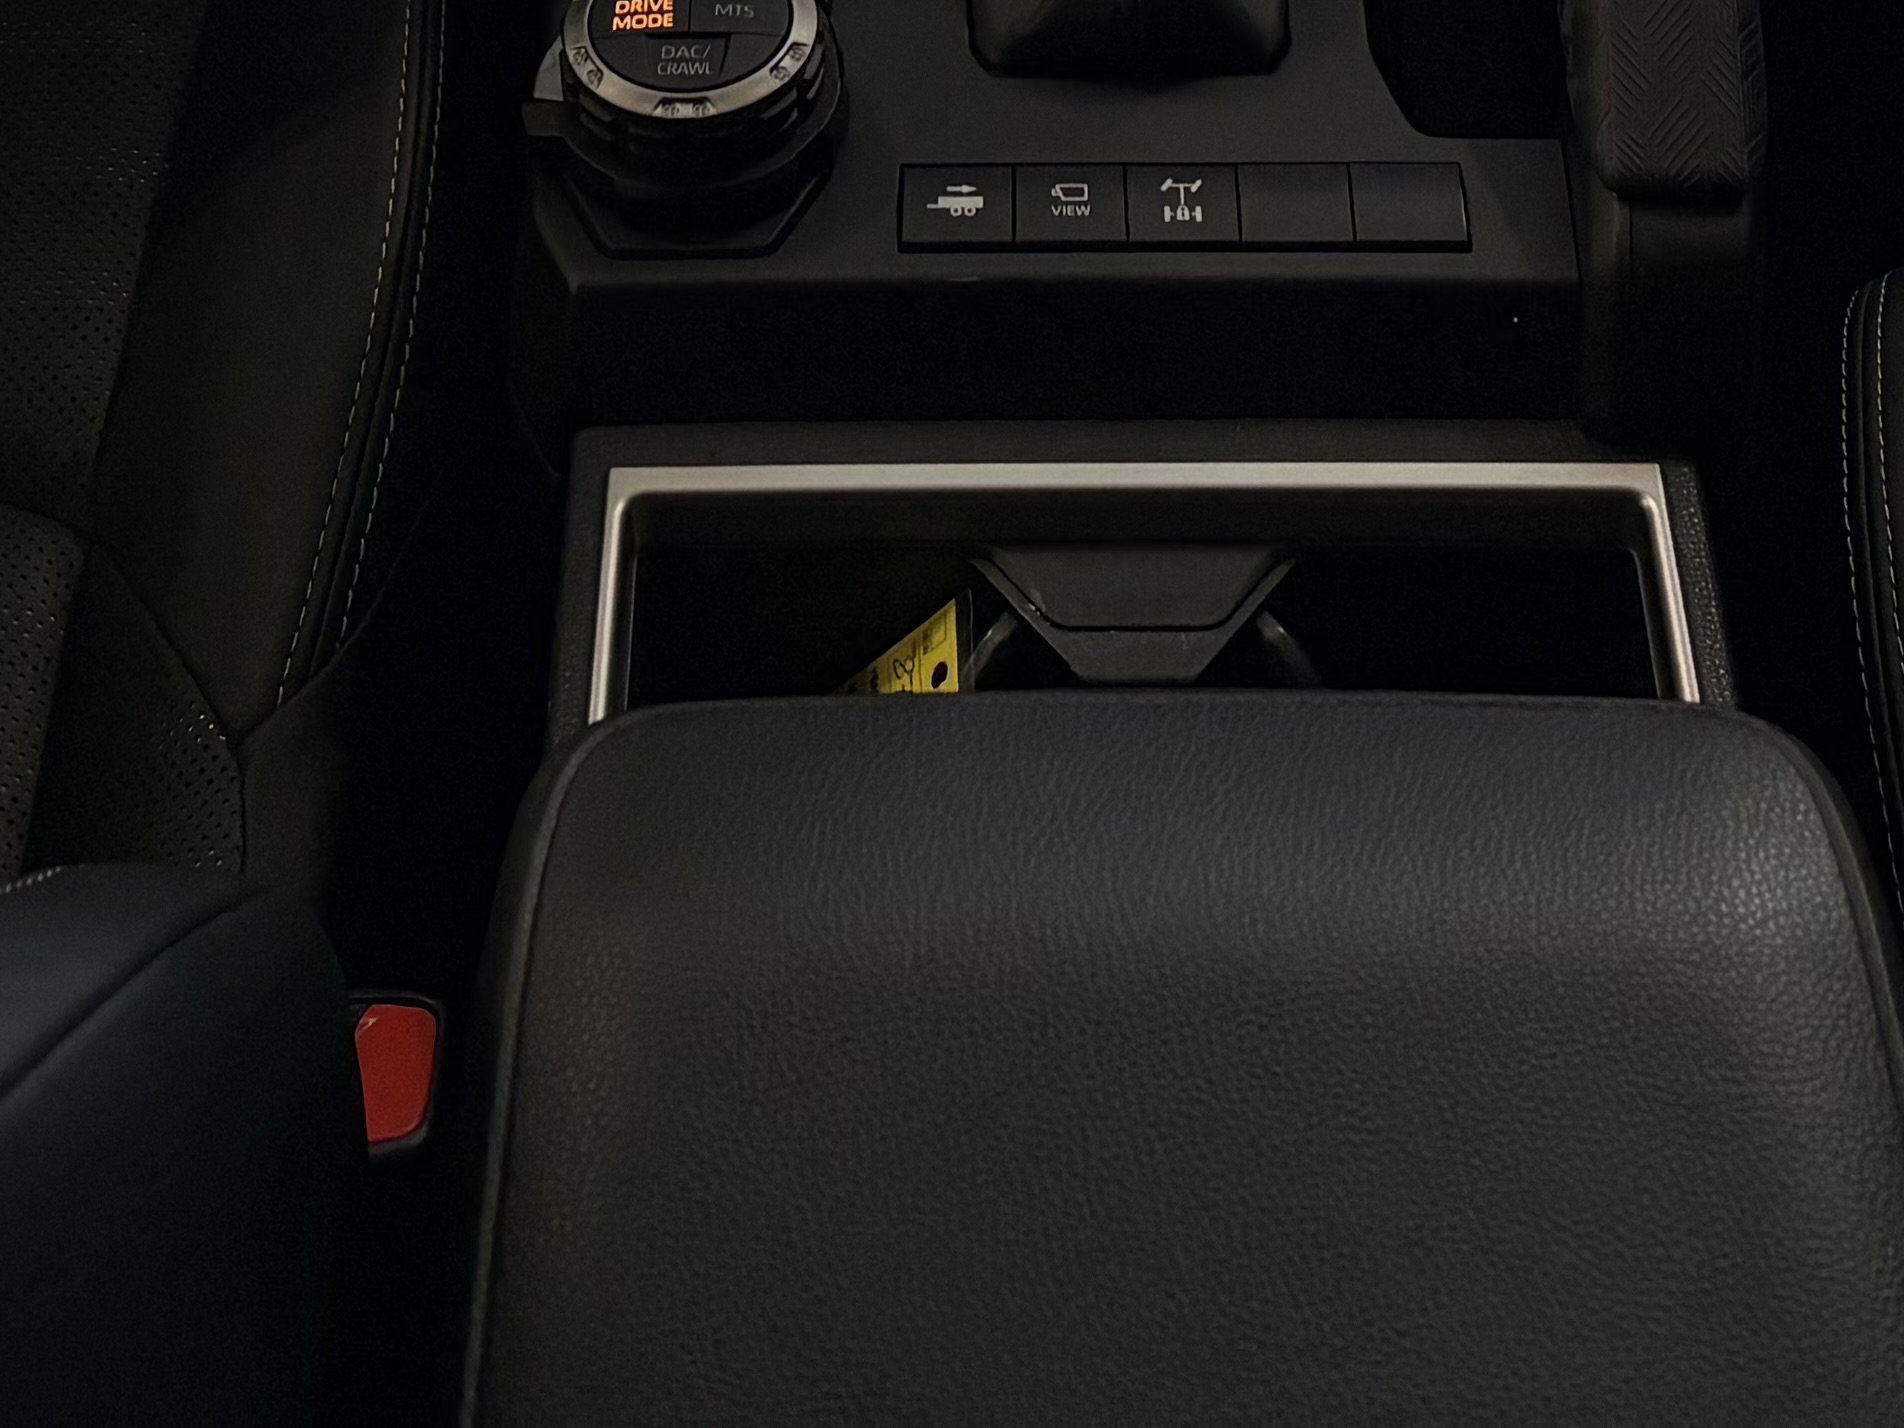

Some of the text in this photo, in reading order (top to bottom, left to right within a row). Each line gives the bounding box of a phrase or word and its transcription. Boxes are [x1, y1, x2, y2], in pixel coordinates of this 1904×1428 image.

[714, 3, 755, 19] MTS
[612, 12, 675, 32] MODE
[661, 44, 712, 61] DAC/
[656, 61, 714, 77] CRAWL
[1050, 205, 1091, 218] VIEW
